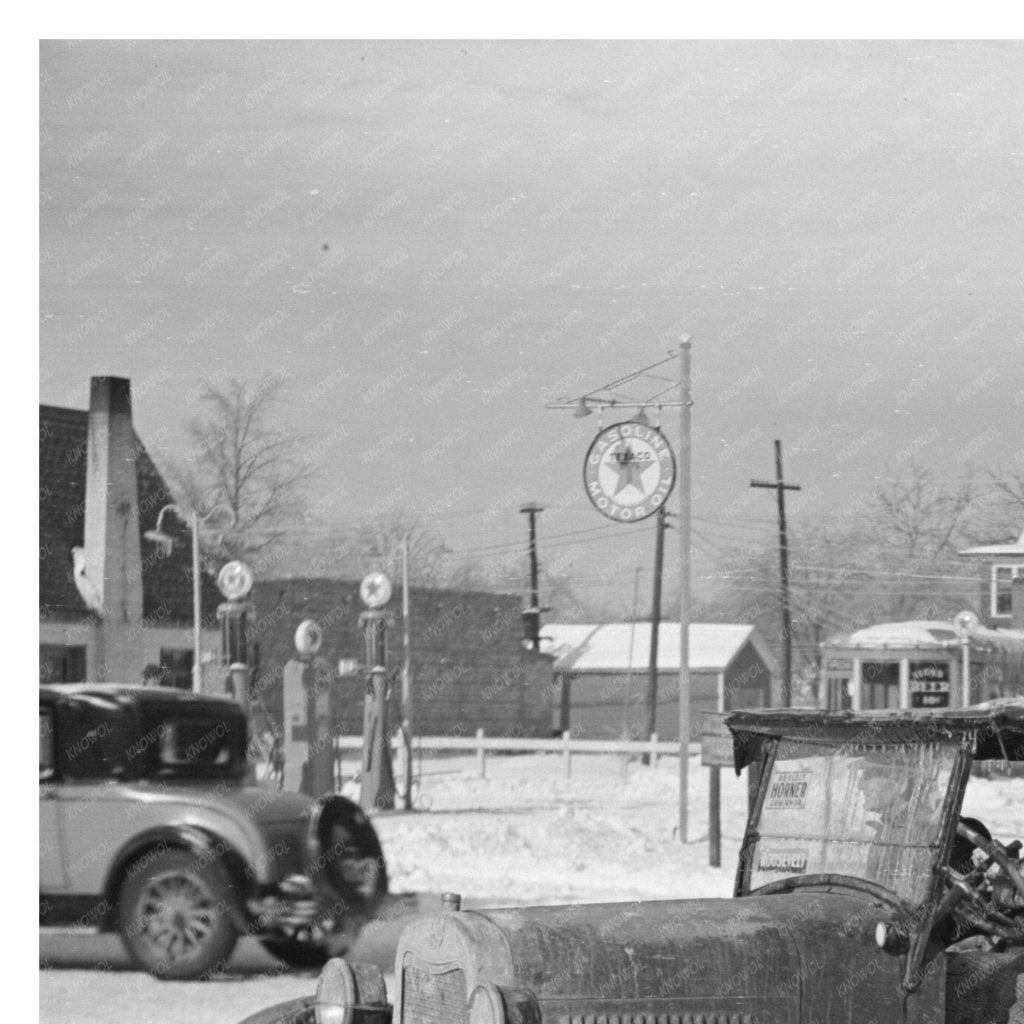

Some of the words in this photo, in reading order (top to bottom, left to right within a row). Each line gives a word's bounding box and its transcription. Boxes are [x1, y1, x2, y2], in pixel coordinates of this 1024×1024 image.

[589, 425, 670, 465] GASOLINE
[588, 481, 646, 519] MOTOR
[650, 476, 672, 505] OIL
[770, 782, 808, 799] HORNER
